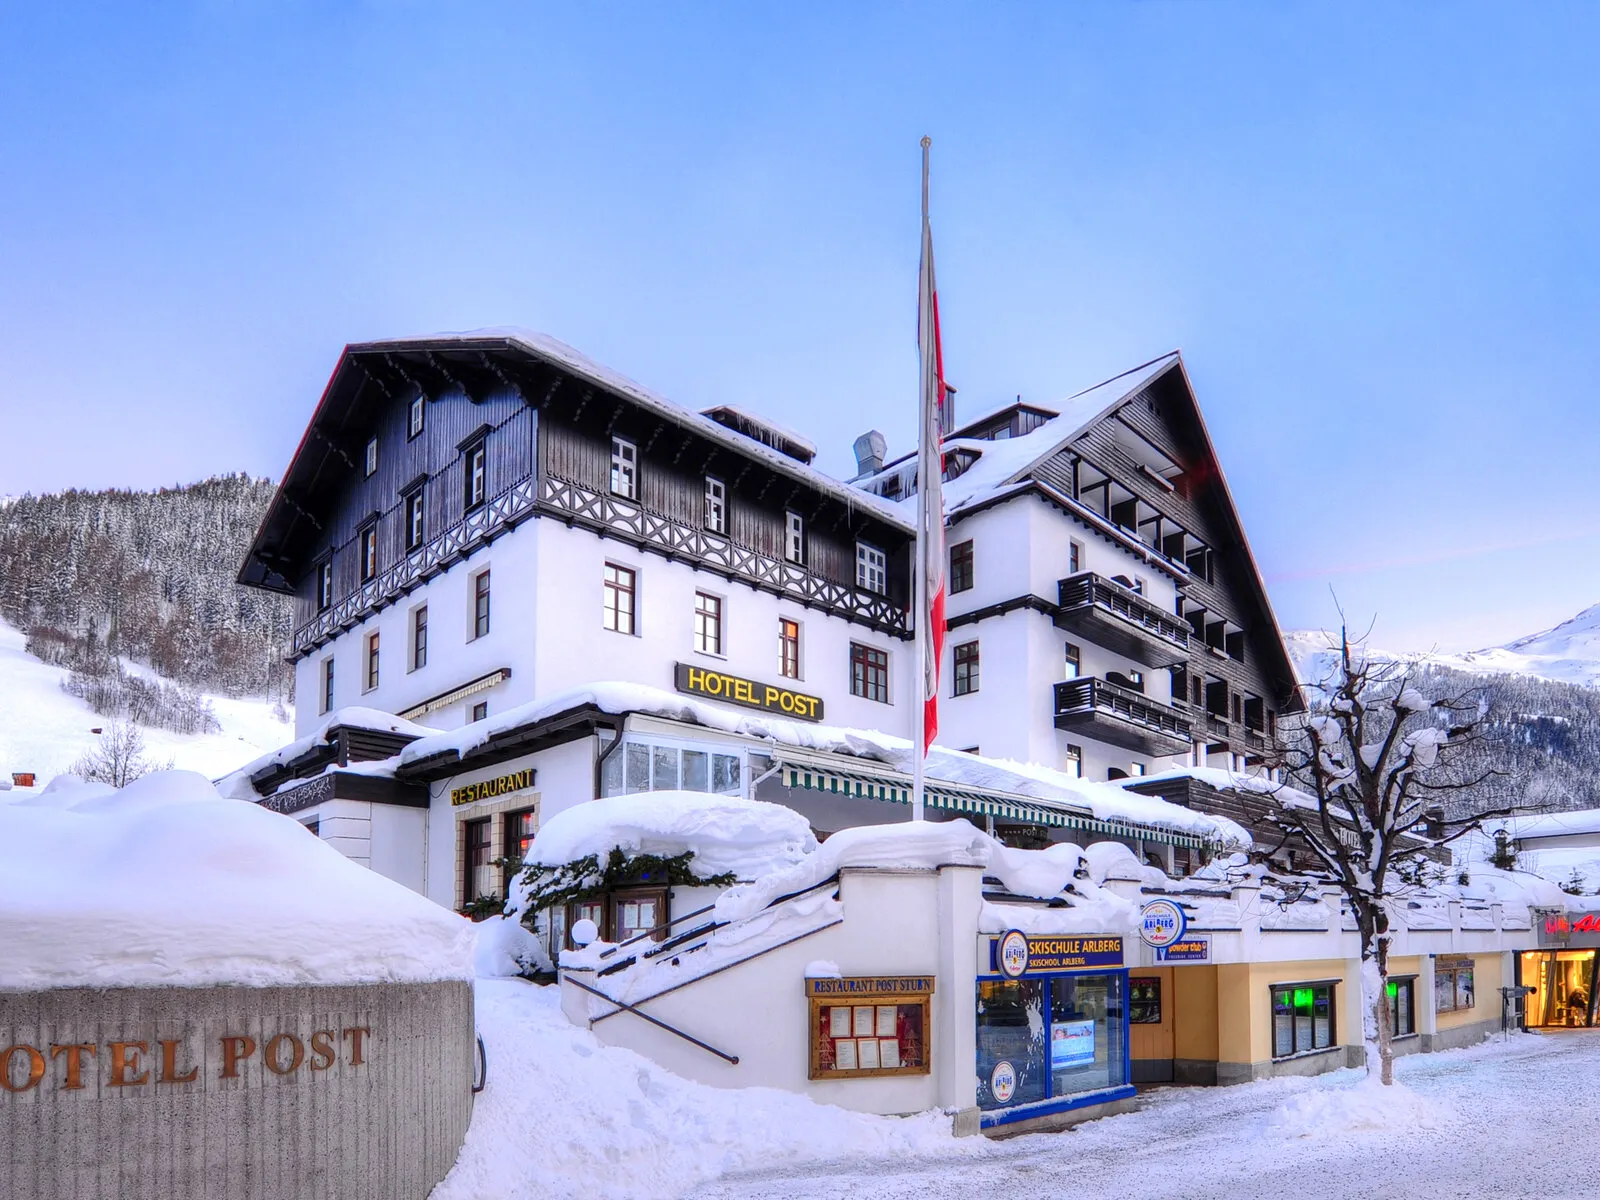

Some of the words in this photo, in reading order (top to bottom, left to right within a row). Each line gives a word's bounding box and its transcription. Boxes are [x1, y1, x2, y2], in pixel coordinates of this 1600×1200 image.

[687, 668, 761, 705] HOTEL
[765, 686, 819, 717] POST
[451, 767, 533, 806] RESTAURANT
[1029, 941, 1080, 955] SKISCHULE
[1082, 940, 1121, 953] ARLBERG
[1029, 959, 1061, 967] SKISCHOOL
[1062, 957, 1086, 966] ARLBERG
[814, 979, 875, 993] RESTAURANT
[876, 979, 899, 992] POST
[0, 1038, 199, 1092] OTEL
[218, 1026, 372, 1080] POST
